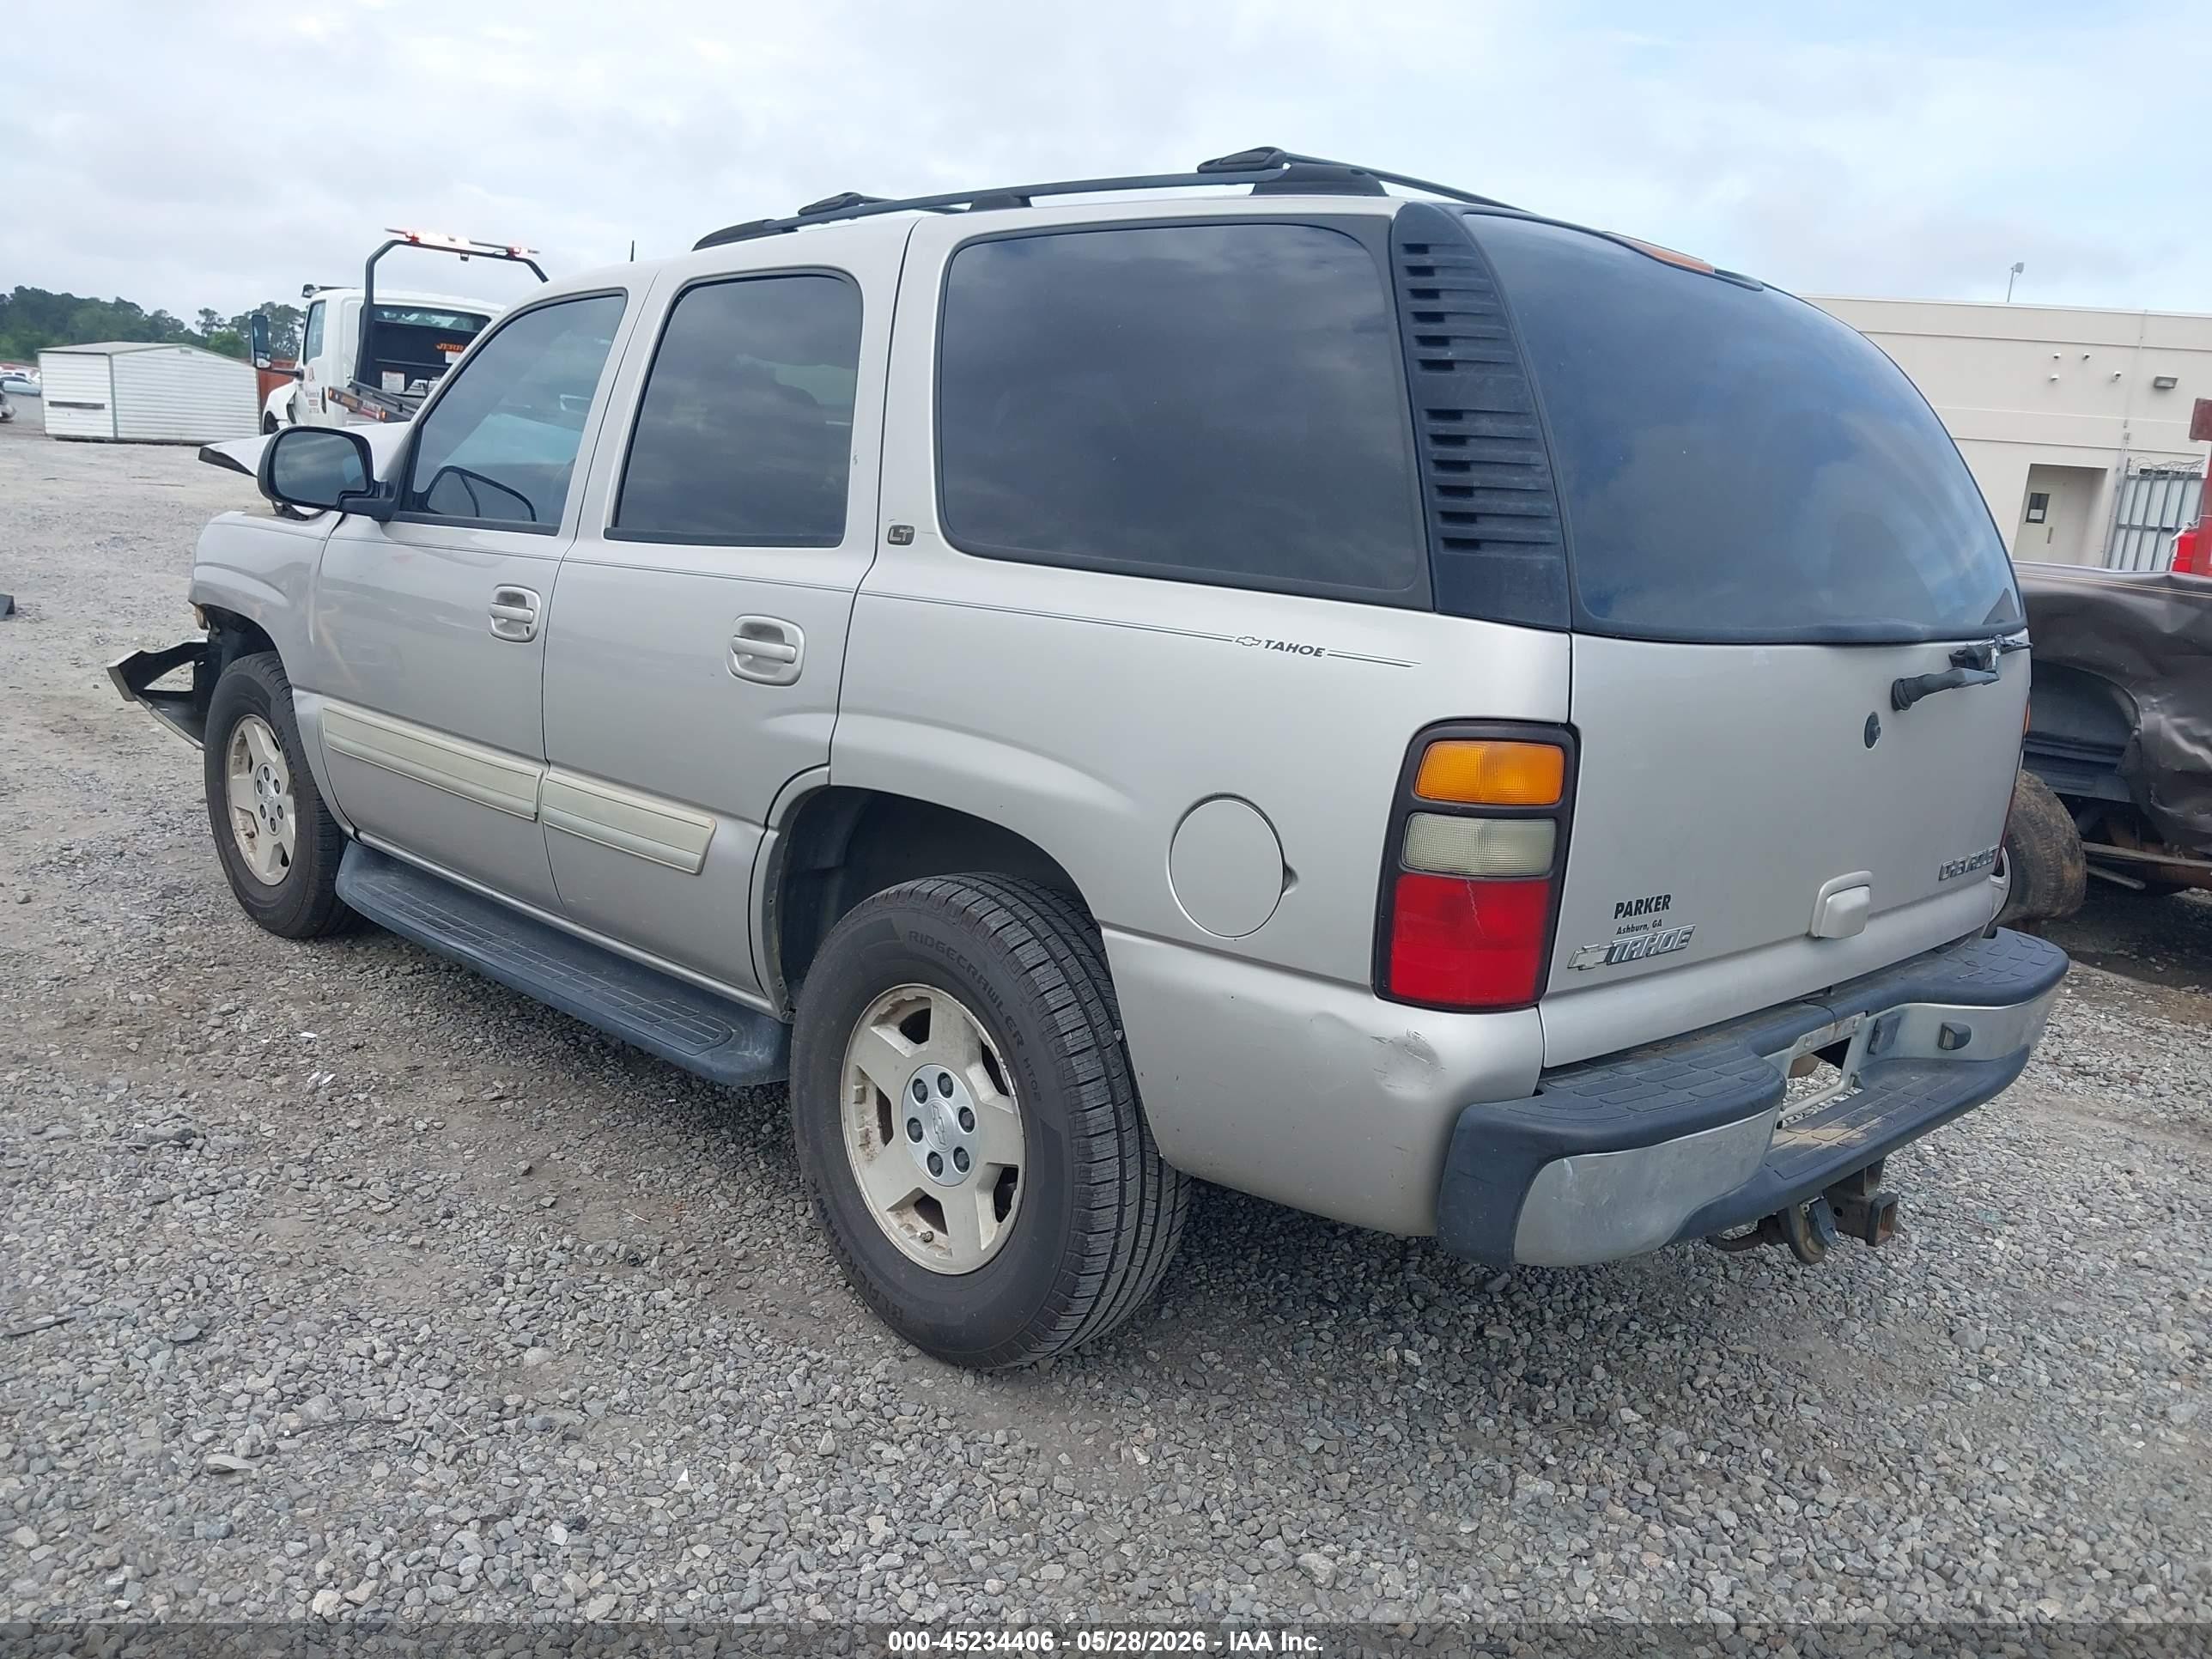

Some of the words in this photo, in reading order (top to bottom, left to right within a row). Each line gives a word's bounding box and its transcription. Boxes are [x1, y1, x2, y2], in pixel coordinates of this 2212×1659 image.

[889, 527, 915, 542] LT
[1263, 639, 1326, 658] TAHOE
[1613, 894, 1672, 920] PARKER
[1616, 922, 1650, 935] Ashburn,
[1652, 919, 1662, 928] GA
[1605, 924, 1696, 966] TAHOE
[908, 929, 1025, 1048] RIDGECRAWLER
